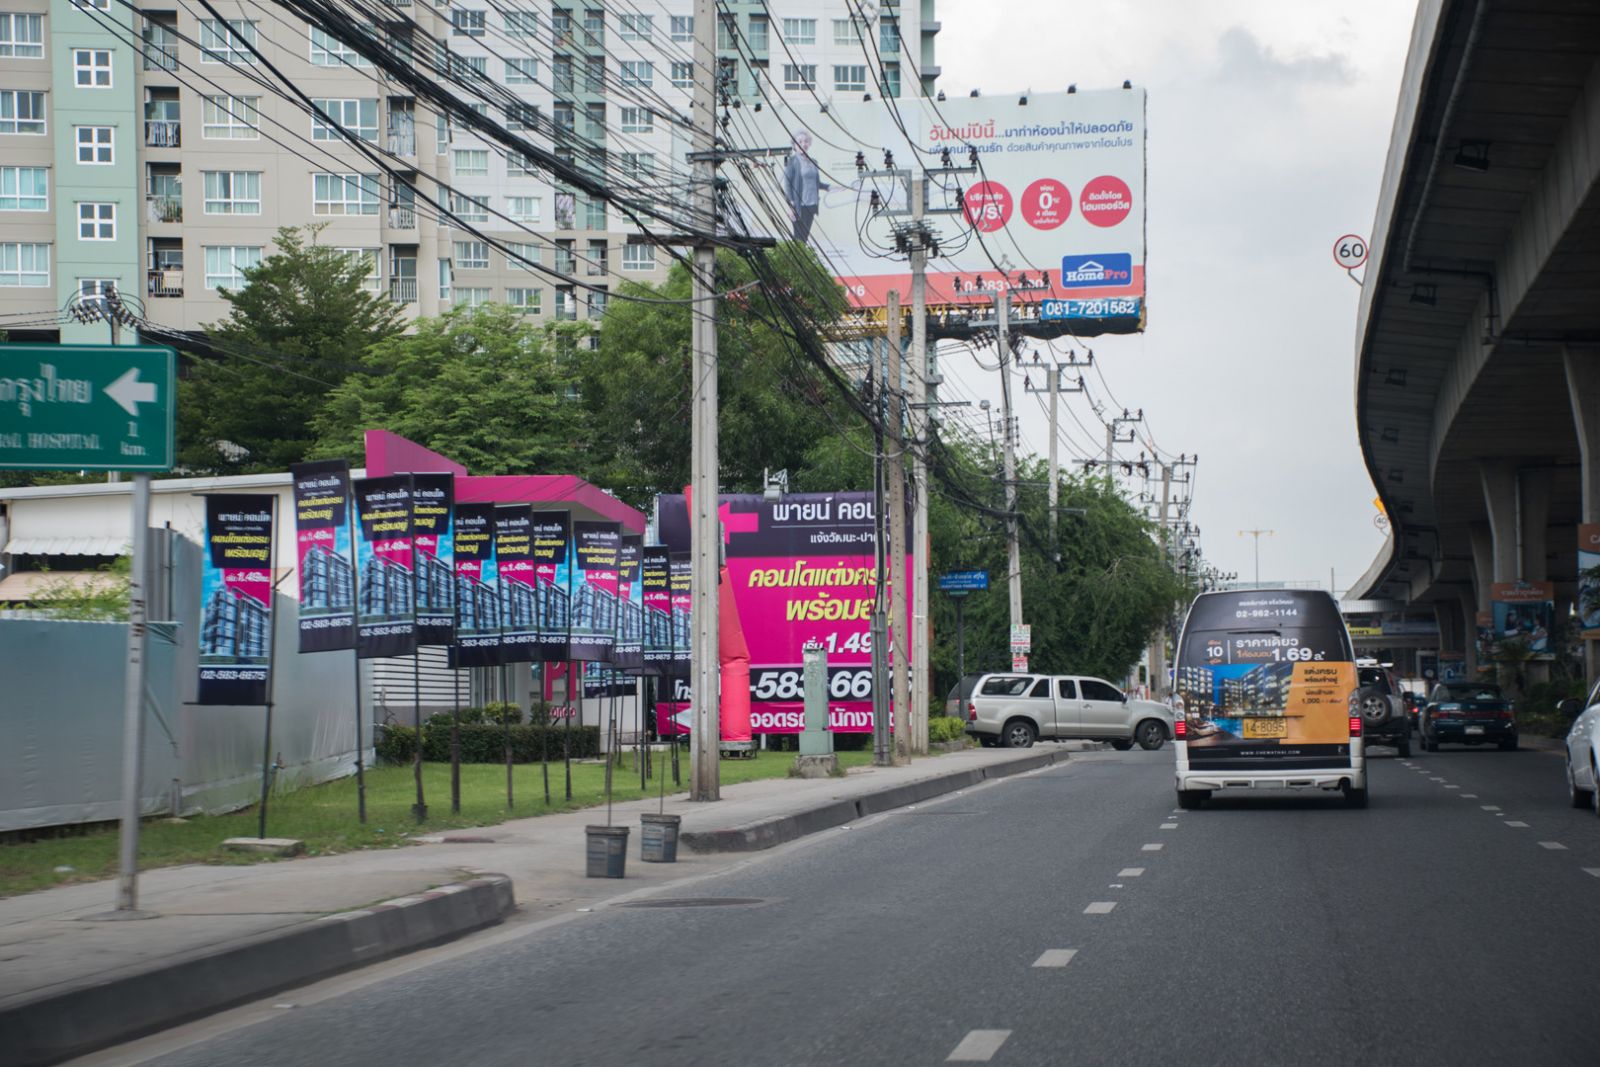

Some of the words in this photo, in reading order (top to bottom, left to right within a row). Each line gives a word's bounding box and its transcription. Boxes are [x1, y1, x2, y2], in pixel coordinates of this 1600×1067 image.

[1340, 243, 1364, 258] 60
[1066, 269, 1128, 282] HomePro
[1046, 301, 1136, 316] 081-7201582
[773, 497, 832, 521] พายน์
[1206, 646, 1224, 657] 10
